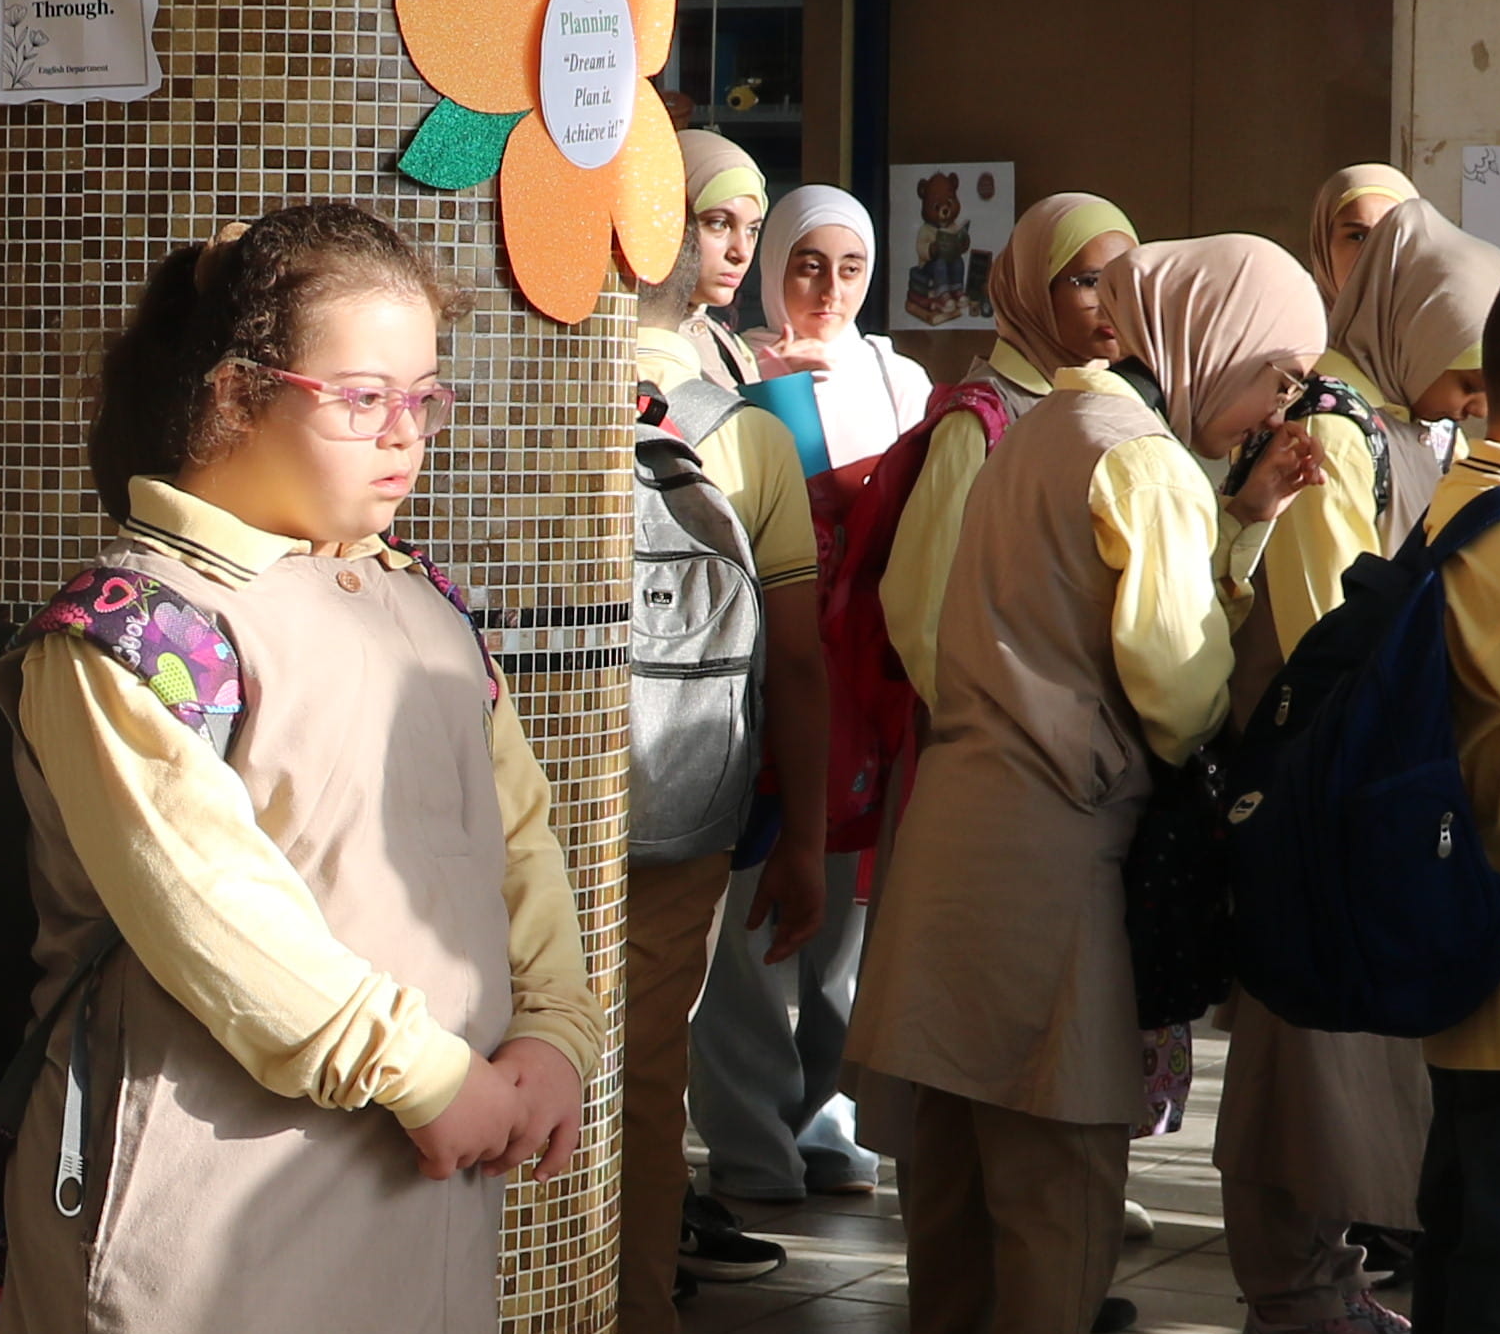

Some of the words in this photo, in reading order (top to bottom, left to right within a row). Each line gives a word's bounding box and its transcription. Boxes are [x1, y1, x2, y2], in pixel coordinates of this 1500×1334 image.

[560, 9, 620, 39] Planning
[574, 87, 600, 108] Plan
[562, 122, 605, 145] Achieve
